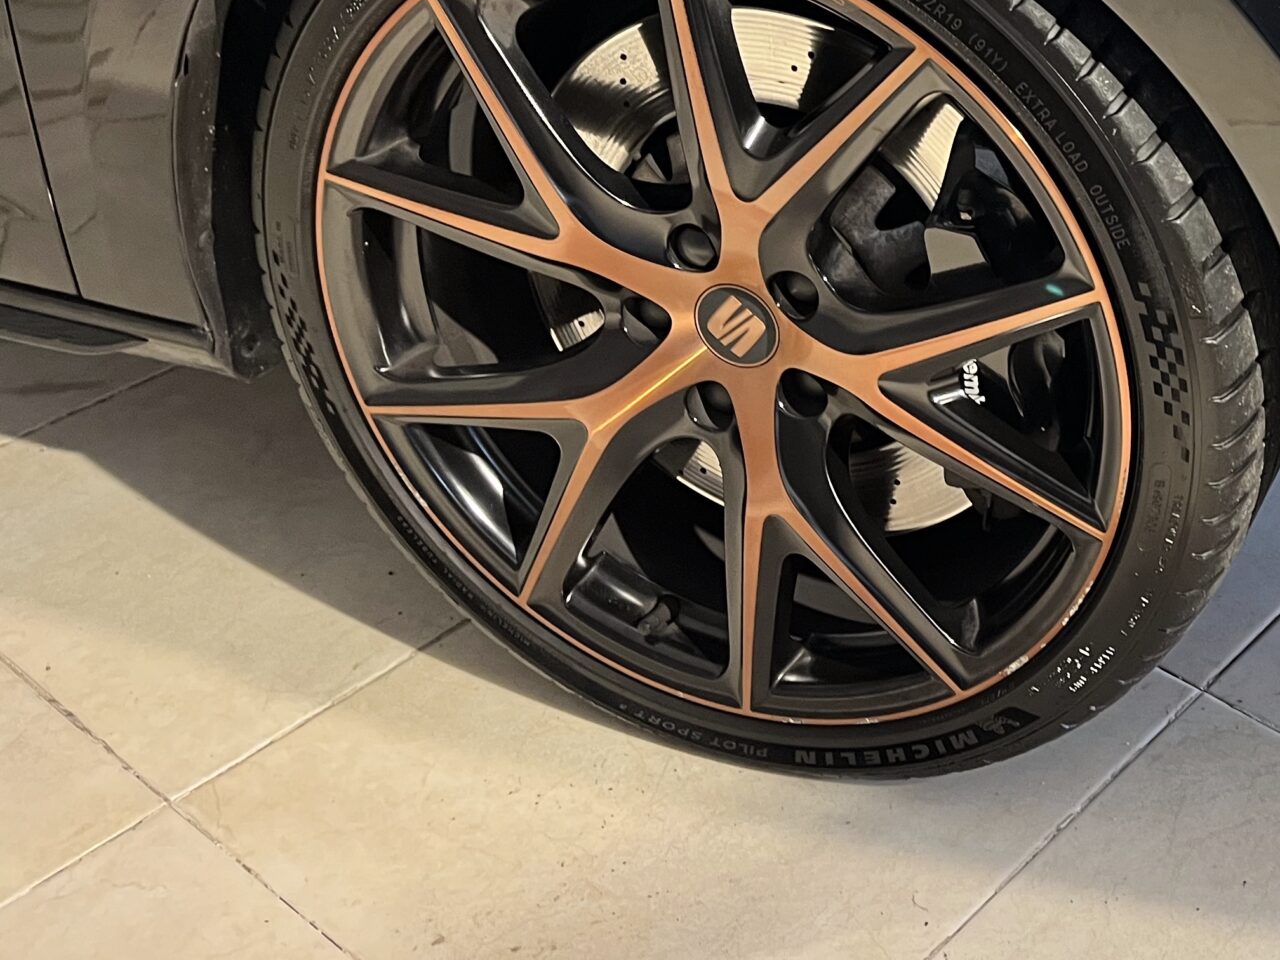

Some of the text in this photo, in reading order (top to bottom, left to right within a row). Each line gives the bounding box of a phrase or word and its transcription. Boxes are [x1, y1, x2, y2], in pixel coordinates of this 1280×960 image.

[968, 33, 1008, 72] (91Y)
[1015, 81, 1131, 249] EXTRA LOAD OUTSIDE
[633, 709, 979, 766] MICHELIN PILOT SPORT
